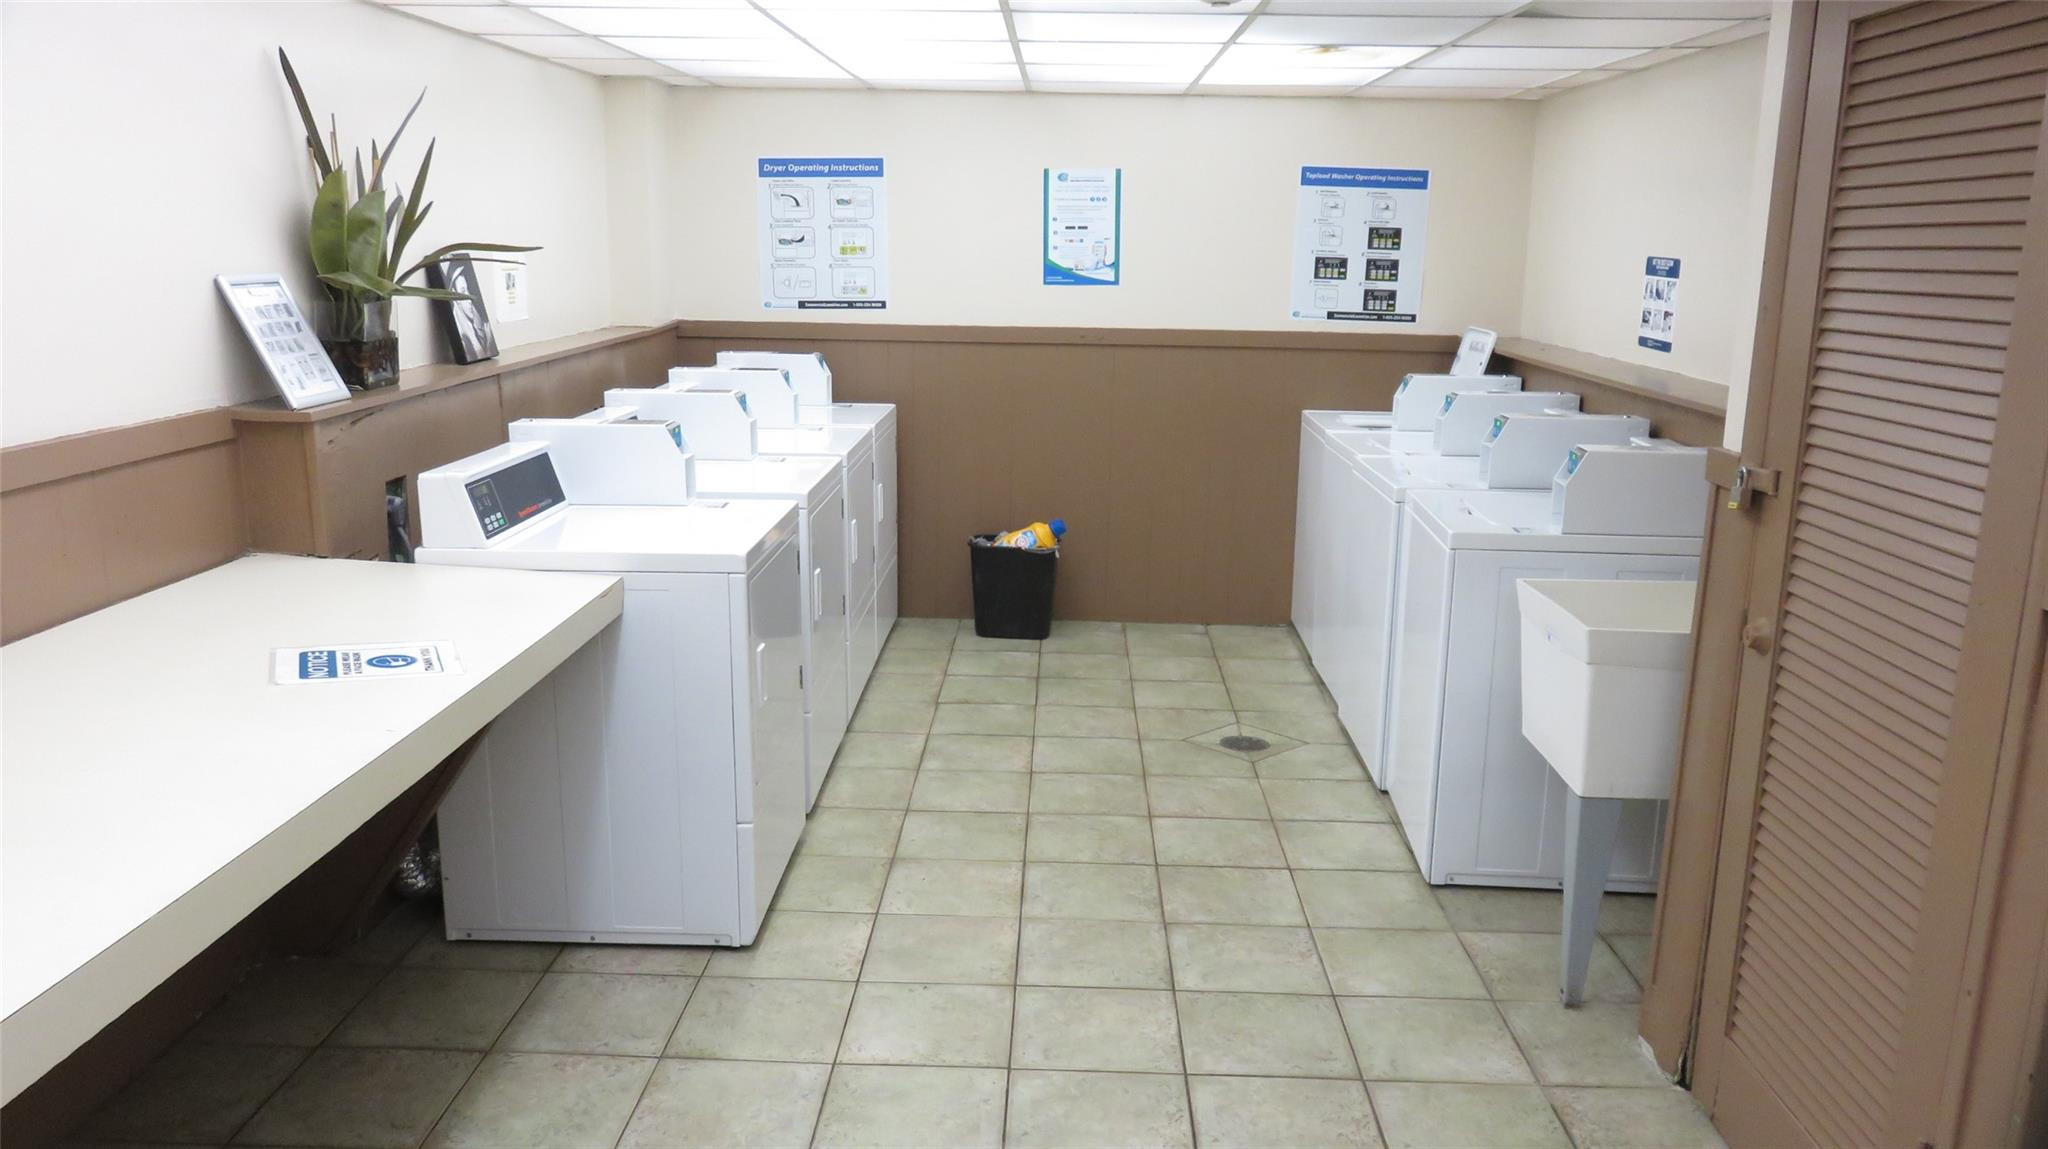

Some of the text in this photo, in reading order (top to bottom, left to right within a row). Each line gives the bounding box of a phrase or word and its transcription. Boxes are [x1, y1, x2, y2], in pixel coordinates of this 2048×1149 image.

[763, 164, 879, 173] Dryer Operating Instructions
[1305, 171, 1331, 180] Topload
[1355, 174, 1387, 182] Operating
[1387, 175, 1424, 183] Instructions
[307, 651, 329, 679] NOTICE
